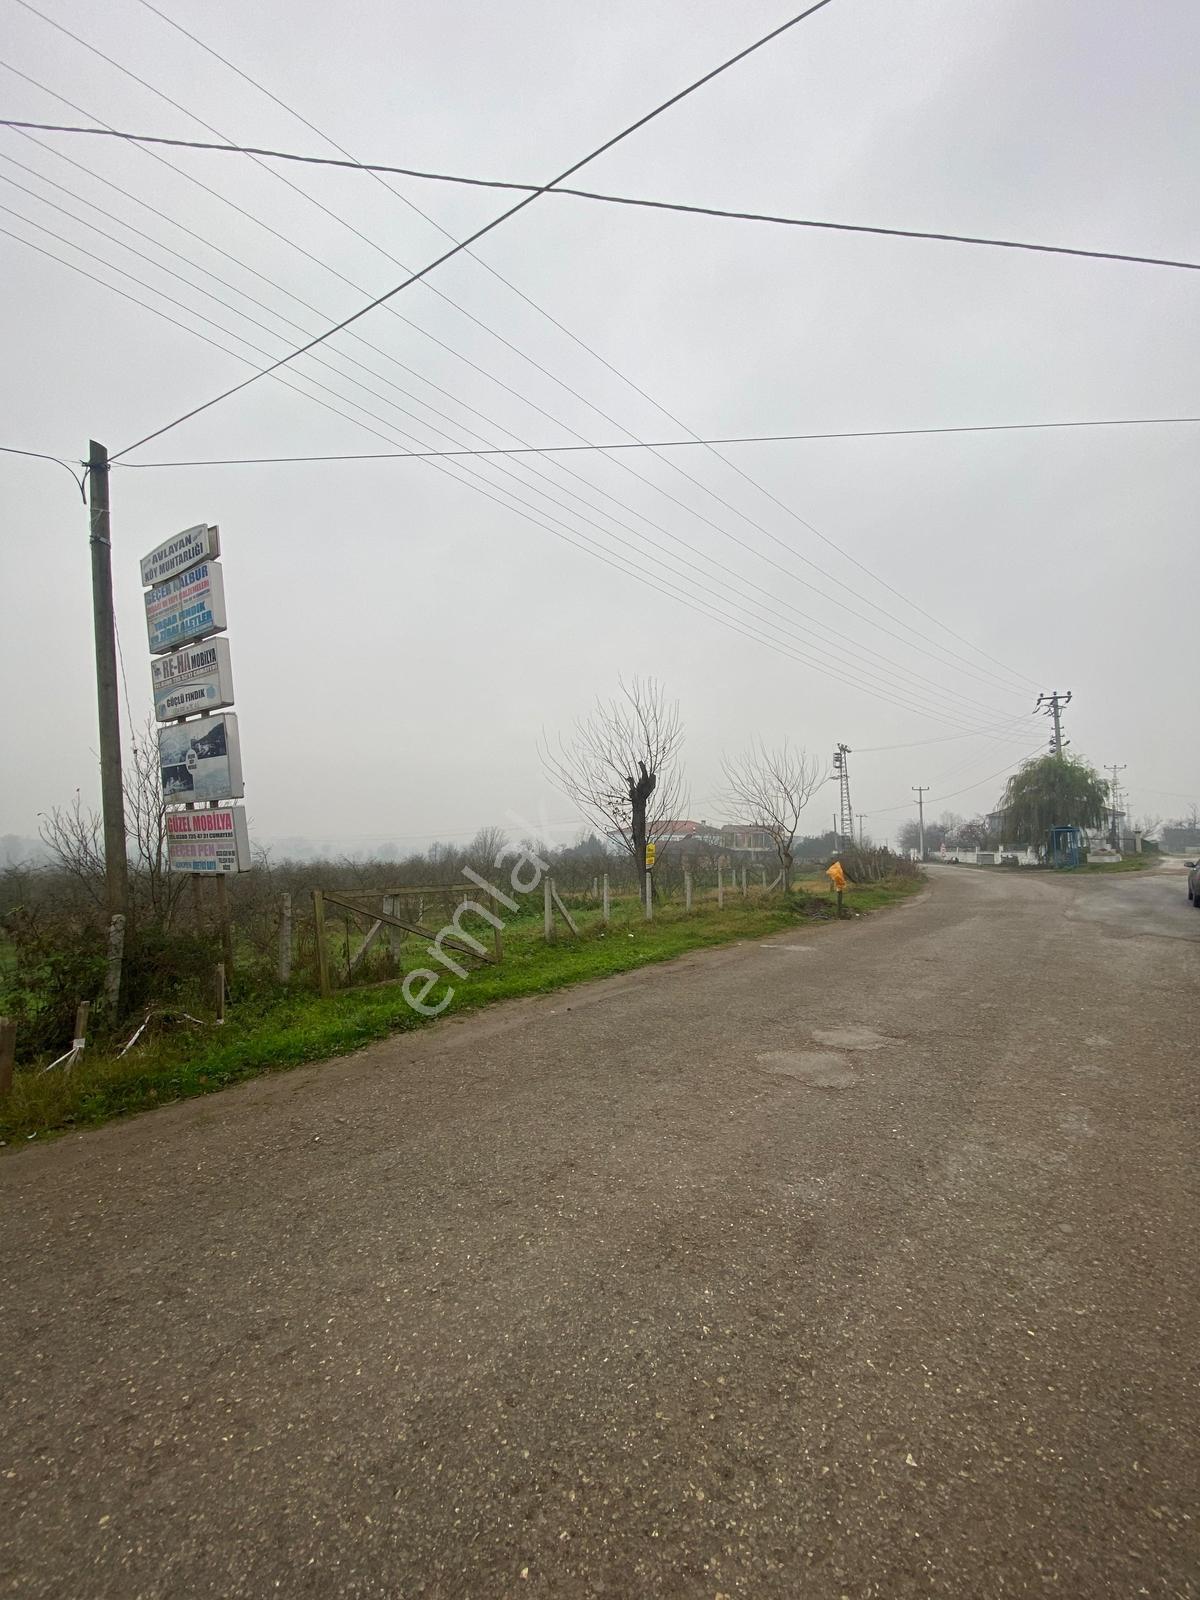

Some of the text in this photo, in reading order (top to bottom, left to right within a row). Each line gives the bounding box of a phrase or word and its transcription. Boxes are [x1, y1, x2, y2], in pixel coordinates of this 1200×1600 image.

[152, 534, 192, 565] AVLAYAN
[159, 542, 203, 575] MUHTARLIĞI
[190, 648, 217, 669] MOBİLYA
[167, 693, 185, 708] GÜÇLÜ
[185, 688, 206, 702] FINDIK
[167, 812, 233, 833] GÜZEL MOBİLYA
